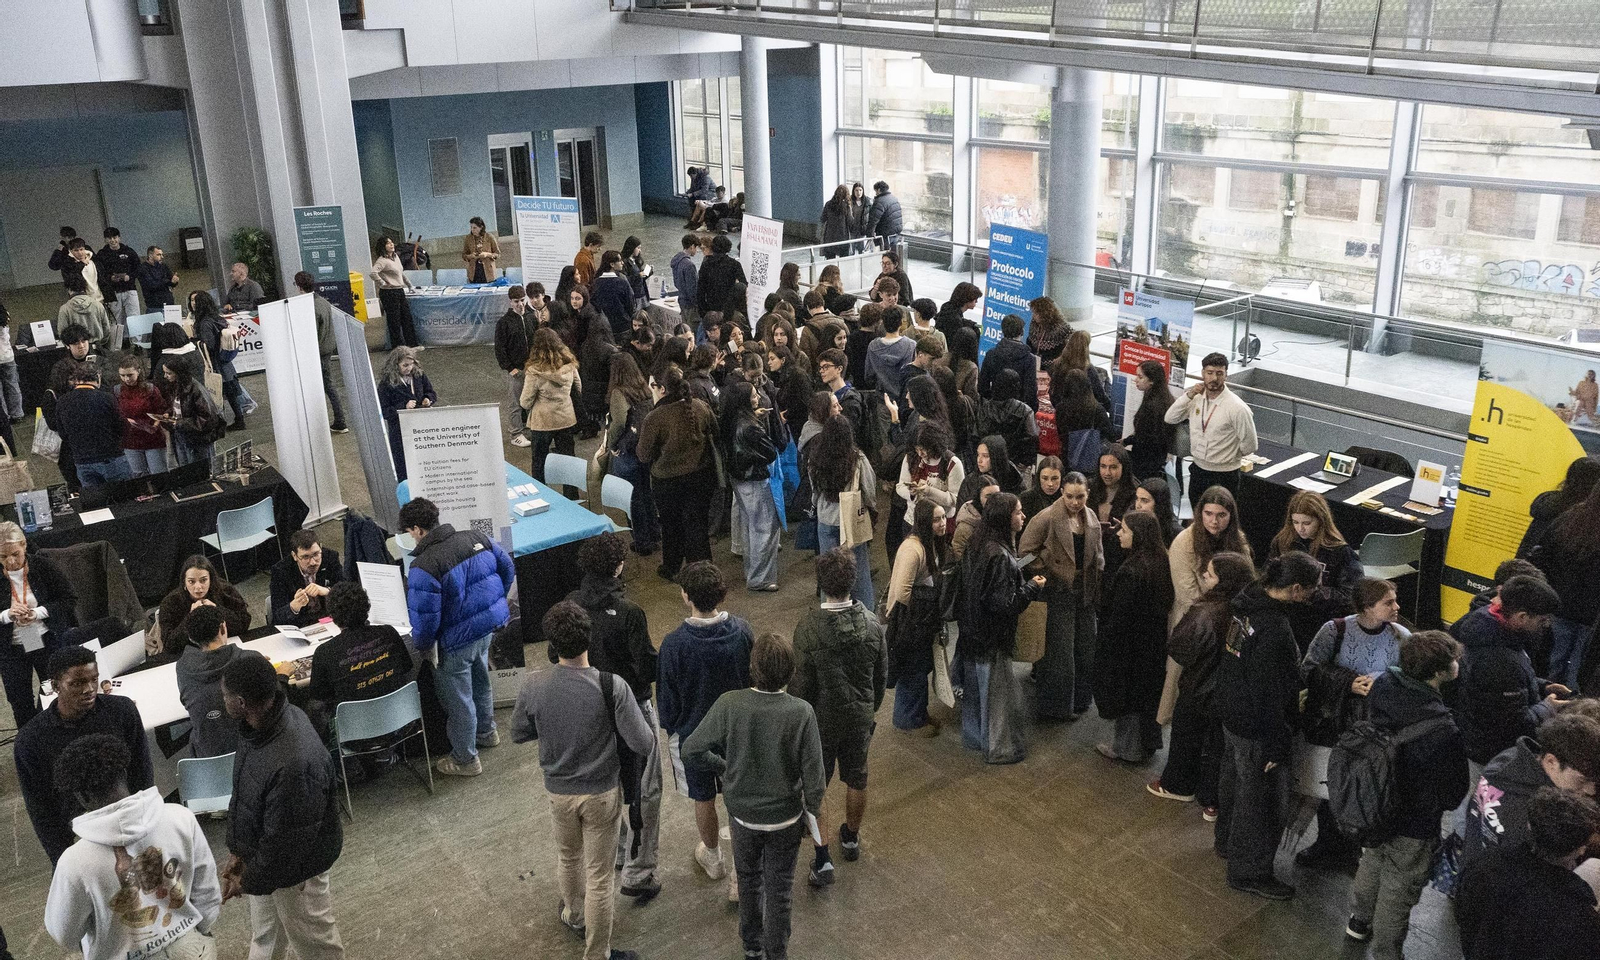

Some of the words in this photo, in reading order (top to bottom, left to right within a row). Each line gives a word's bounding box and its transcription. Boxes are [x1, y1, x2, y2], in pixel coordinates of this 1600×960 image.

[517, 200, 542, 209] Decide
[542, 201, 552, 209] TU
[553, 202, 575, 211] futuro
[992, 232, 1013, 244] CEDEU
[991, 259, 1035, 280] Protocolo
[988, 286, 1031, 312] Marketing
[1135, 294, 1160, 305] Universidad
[986, 306, 1006, 321] Dere
[237, 338, 263, 353] che
[451, 424, 481, 432] engineer
[436, 432, 472, 440] University
[414, 442, 446, 450] Southern
[446, 439, 479, 448] Denmark
[445, 469, 479, 477] international
[451, 503, 477, 511] guarantee
[145, 917, 195, 952] Rochelle
